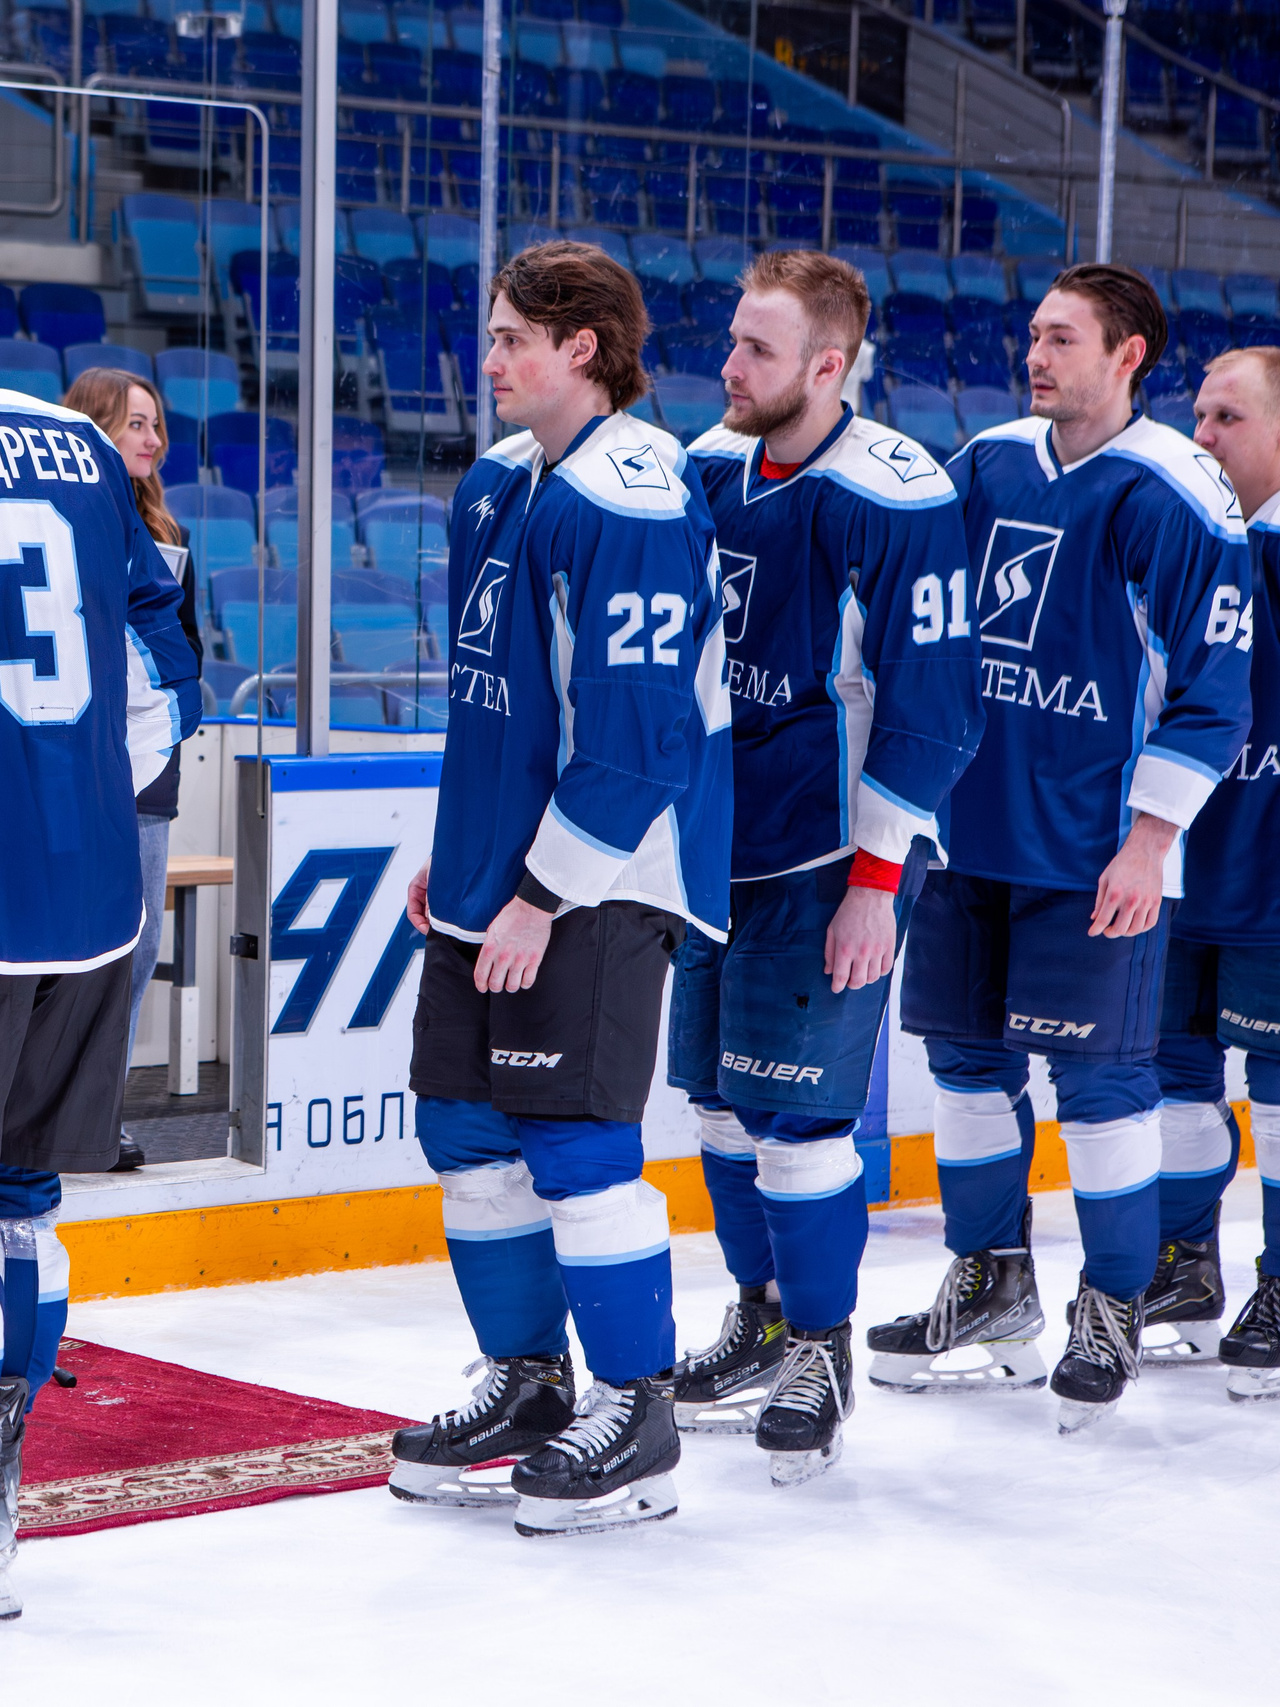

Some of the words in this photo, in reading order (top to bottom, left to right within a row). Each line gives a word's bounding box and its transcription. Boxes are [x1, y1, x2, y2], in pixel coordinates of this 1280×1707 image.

[911, 568, 972, 646] 91
[607, 591, 688, 667] 22
[981, 657, 1108, 722] ТЕМА
[1008, 1012, 1096, 1040] CCM
[491, 1048, 563, 1069] CCM
[722, 1051, 824, 1087] BAUER
[714, 1361, 760, 1392] BAUER
[469, 1419, 511, 1447] BAUER
[602, 1443, 640, 1474] BAUER
